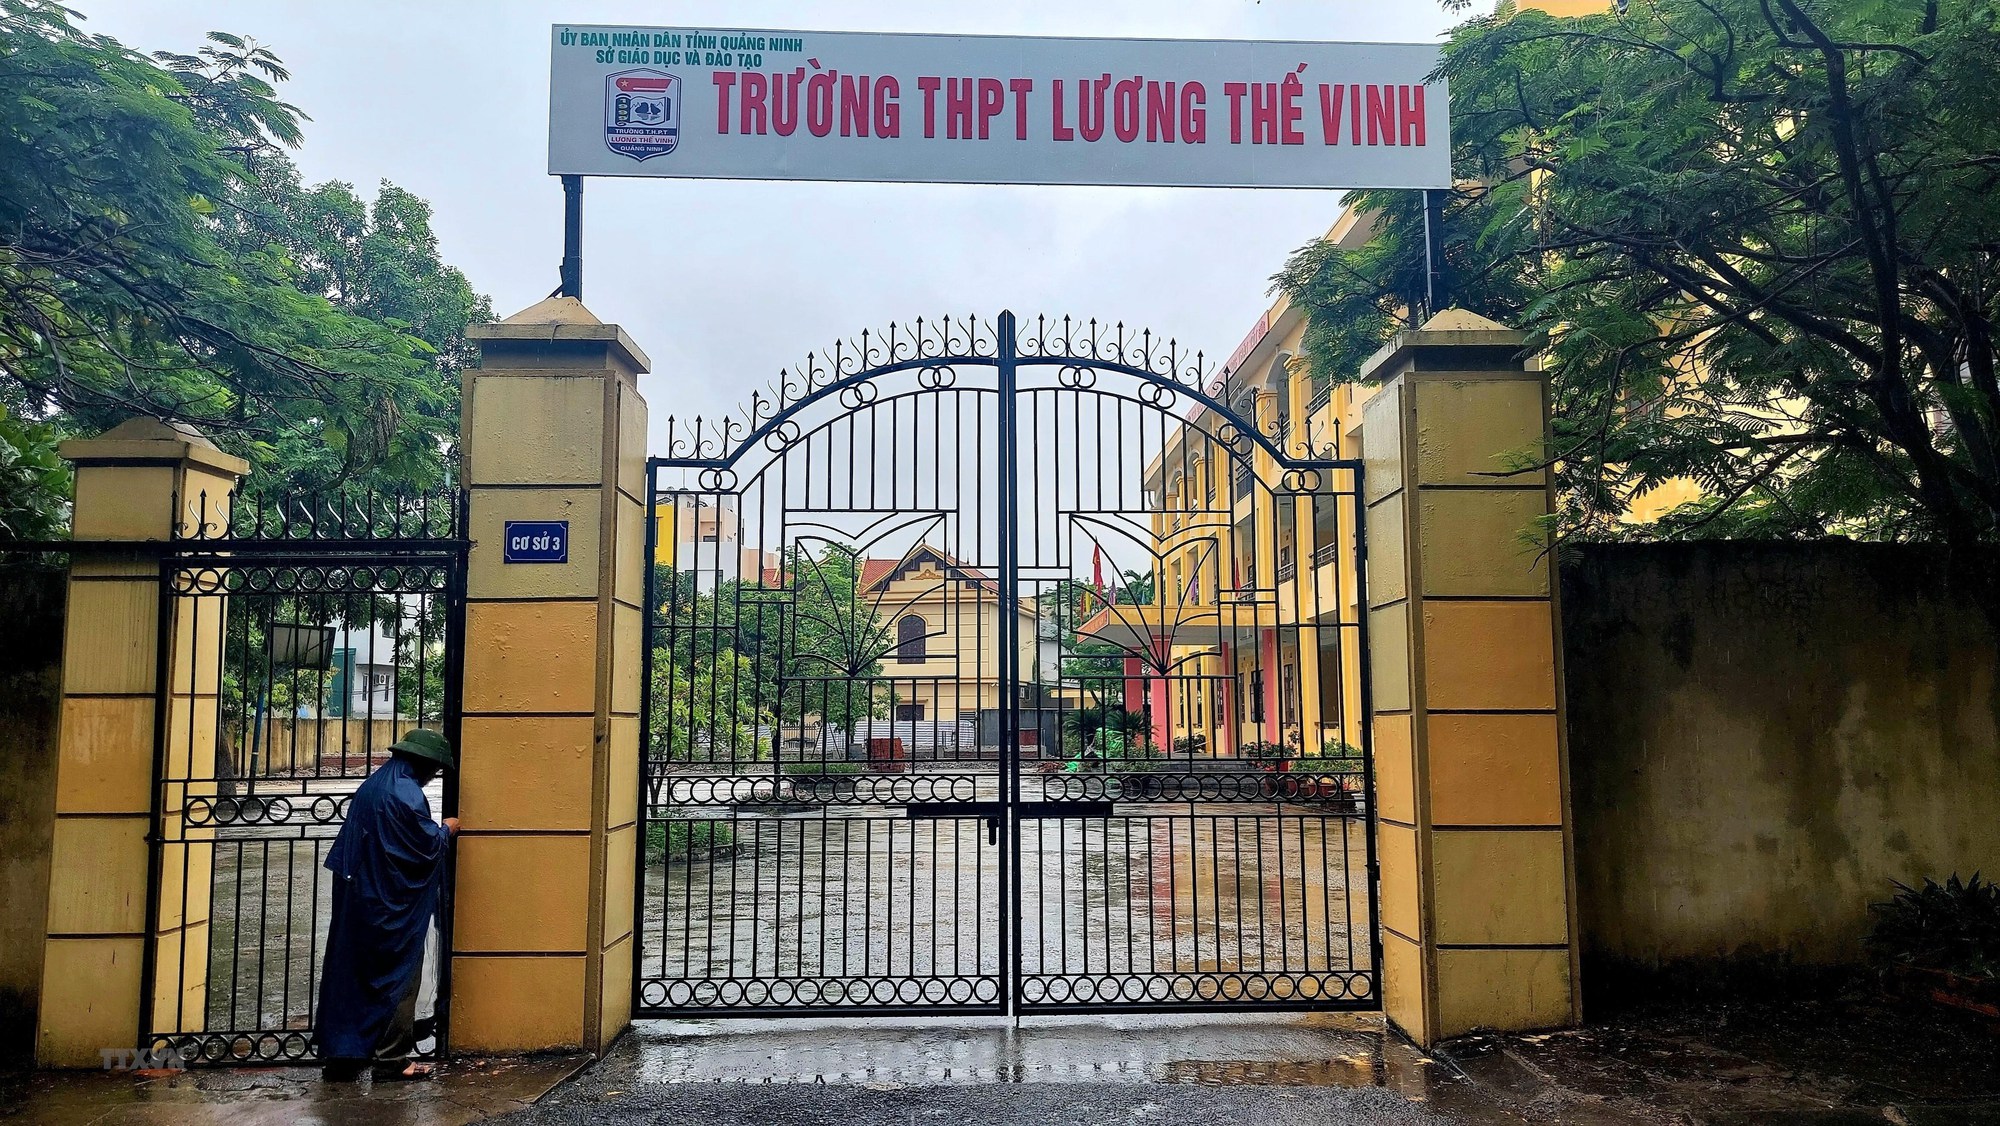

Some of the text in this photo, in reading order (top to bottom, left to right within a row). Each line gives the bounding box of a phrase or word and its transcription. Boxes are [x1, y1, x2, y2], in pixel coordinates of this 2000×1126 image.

[561, 28, 802, 51] ỦY BAN NHÂN DÂN TỈNH QUẢNG NINH
[596, 46, 761, 70] SỞ GIÁO DỤC VÀ ĐÀO TẠO
[713, 58, 1426, 147] TRƯỜNG THPT LƯƠNG THẾ VINH
[512, 531, 560, 550] CƠ SỞ 3
